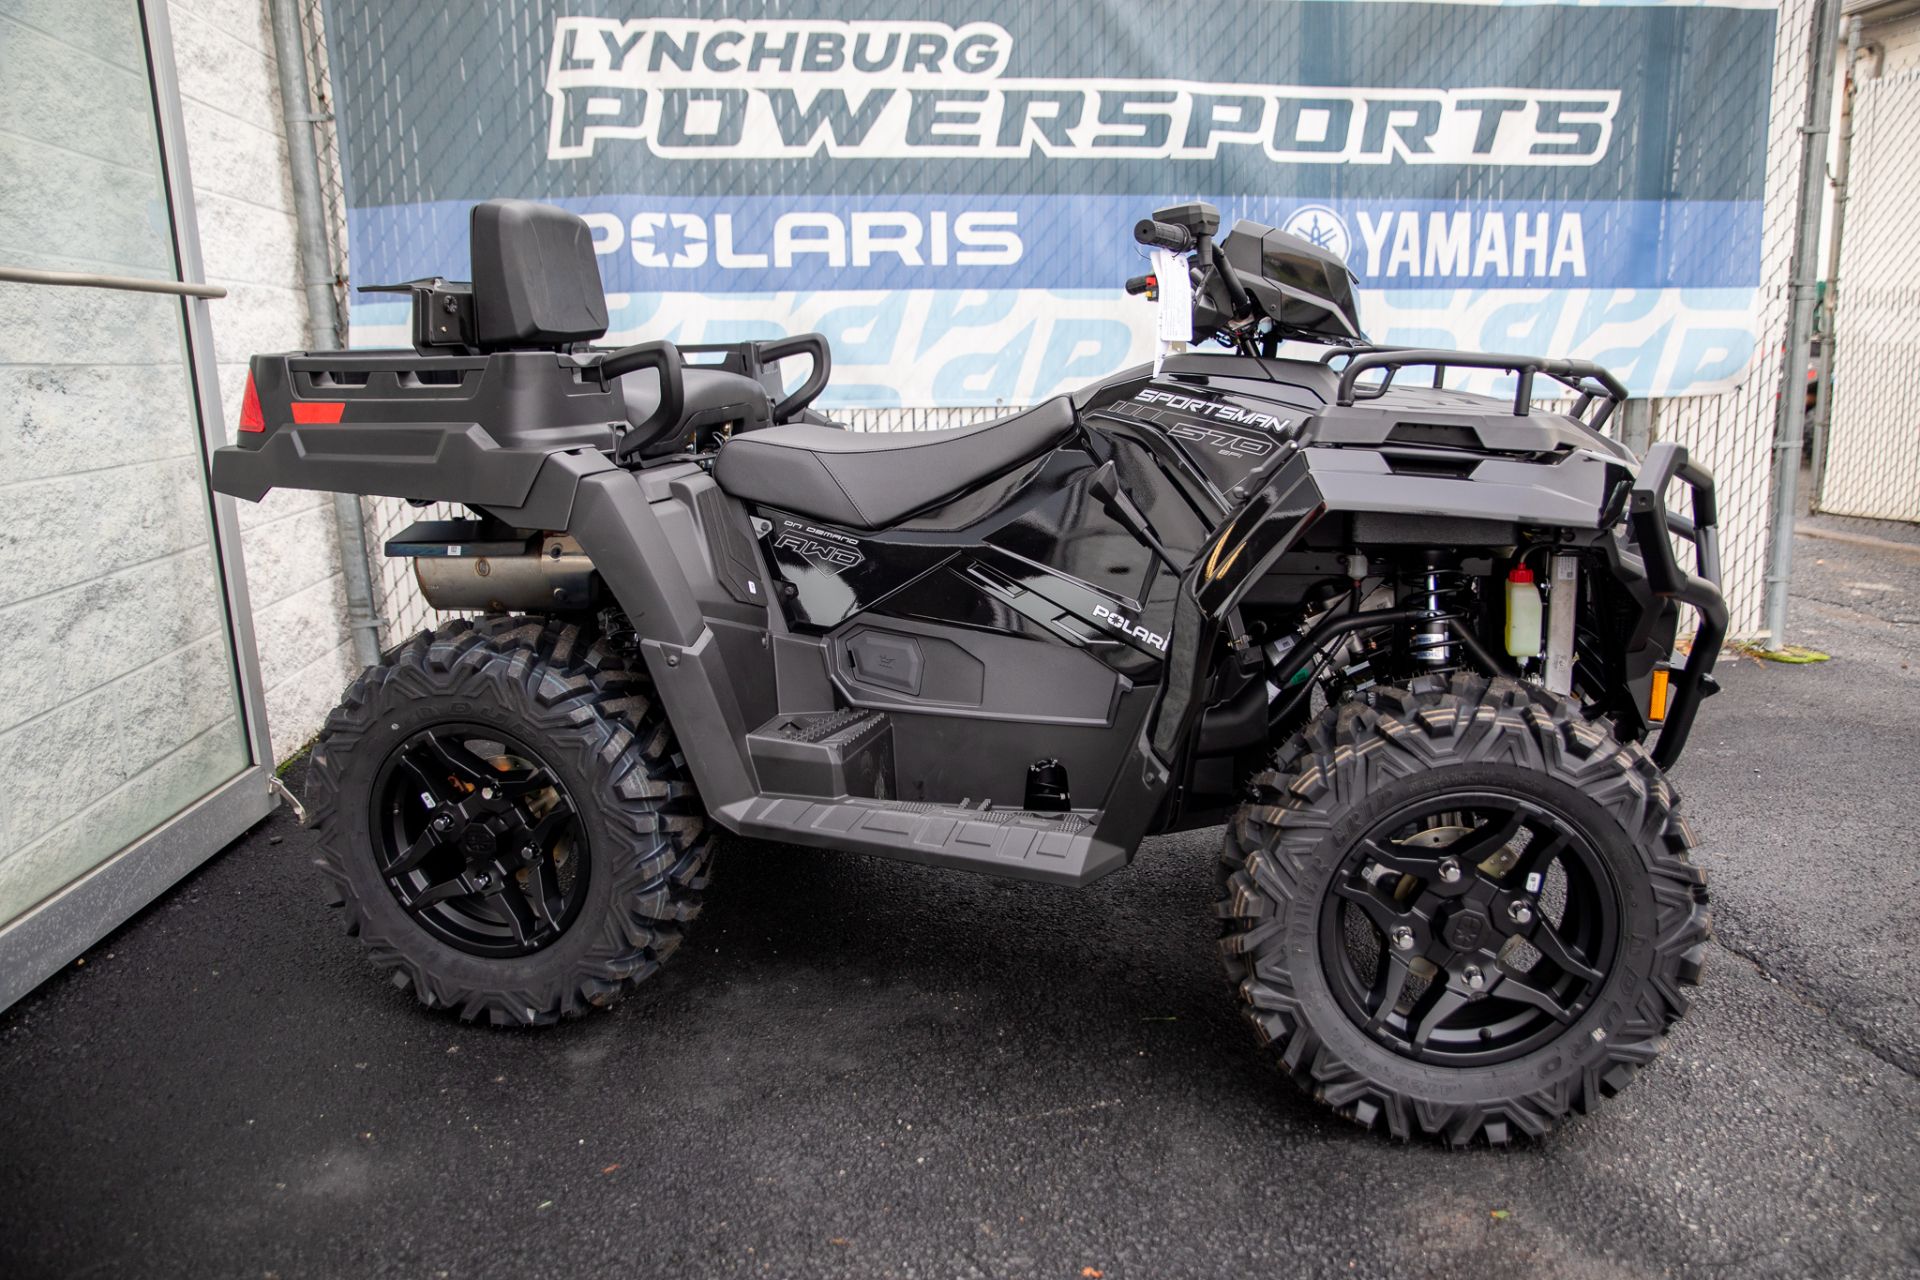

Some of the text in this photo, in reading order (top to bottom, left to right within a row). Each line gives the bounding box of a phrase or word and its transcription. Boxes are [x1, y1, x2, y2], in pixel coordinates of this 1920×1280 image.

[557, 28, 1002, 75] LYNCHBURG
[557, 85, 1609, 158] POWERSPORTS
[1356, 210, 1588, 278] YAMAHA
[1134, 388, 1291, 433] SPORTSMAN
[1167, 422, 1273, 456] 570
[774, 533, 862, 568] AWD
[1092, 604, 1172, 652] POLARI
